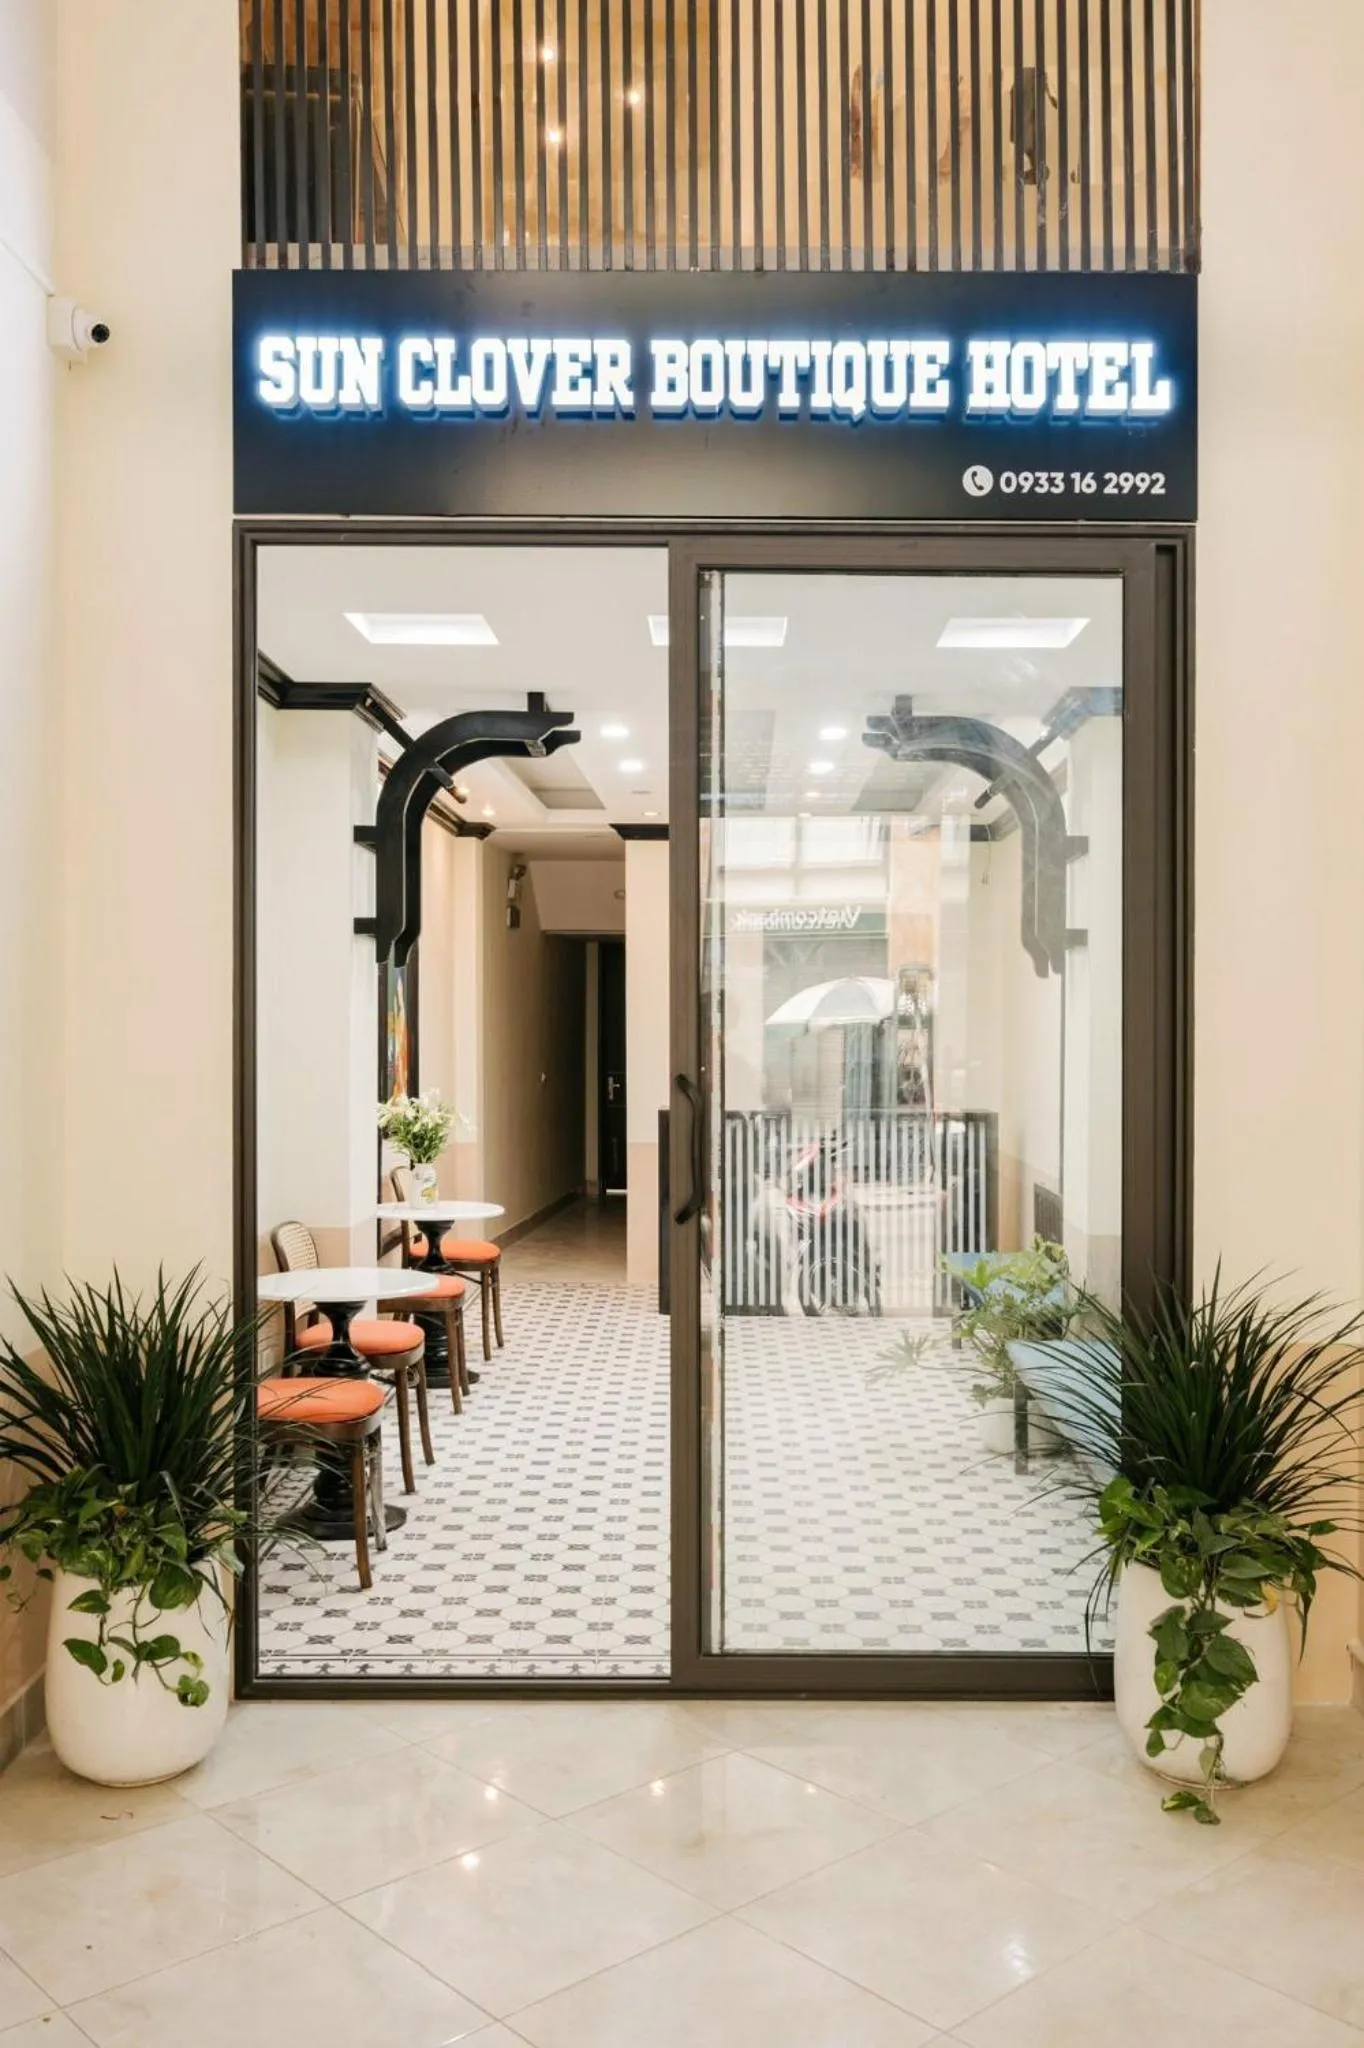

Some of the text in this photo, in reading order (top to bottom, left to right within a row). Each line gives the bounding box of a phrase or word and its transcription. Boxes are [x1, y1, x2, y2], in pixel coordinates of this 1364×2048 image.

[257, 335, 1172, 415] SUN CLOVER BOUTIQUE HOTEL
[999, 471, 1167, 496] 0933 16 2992
